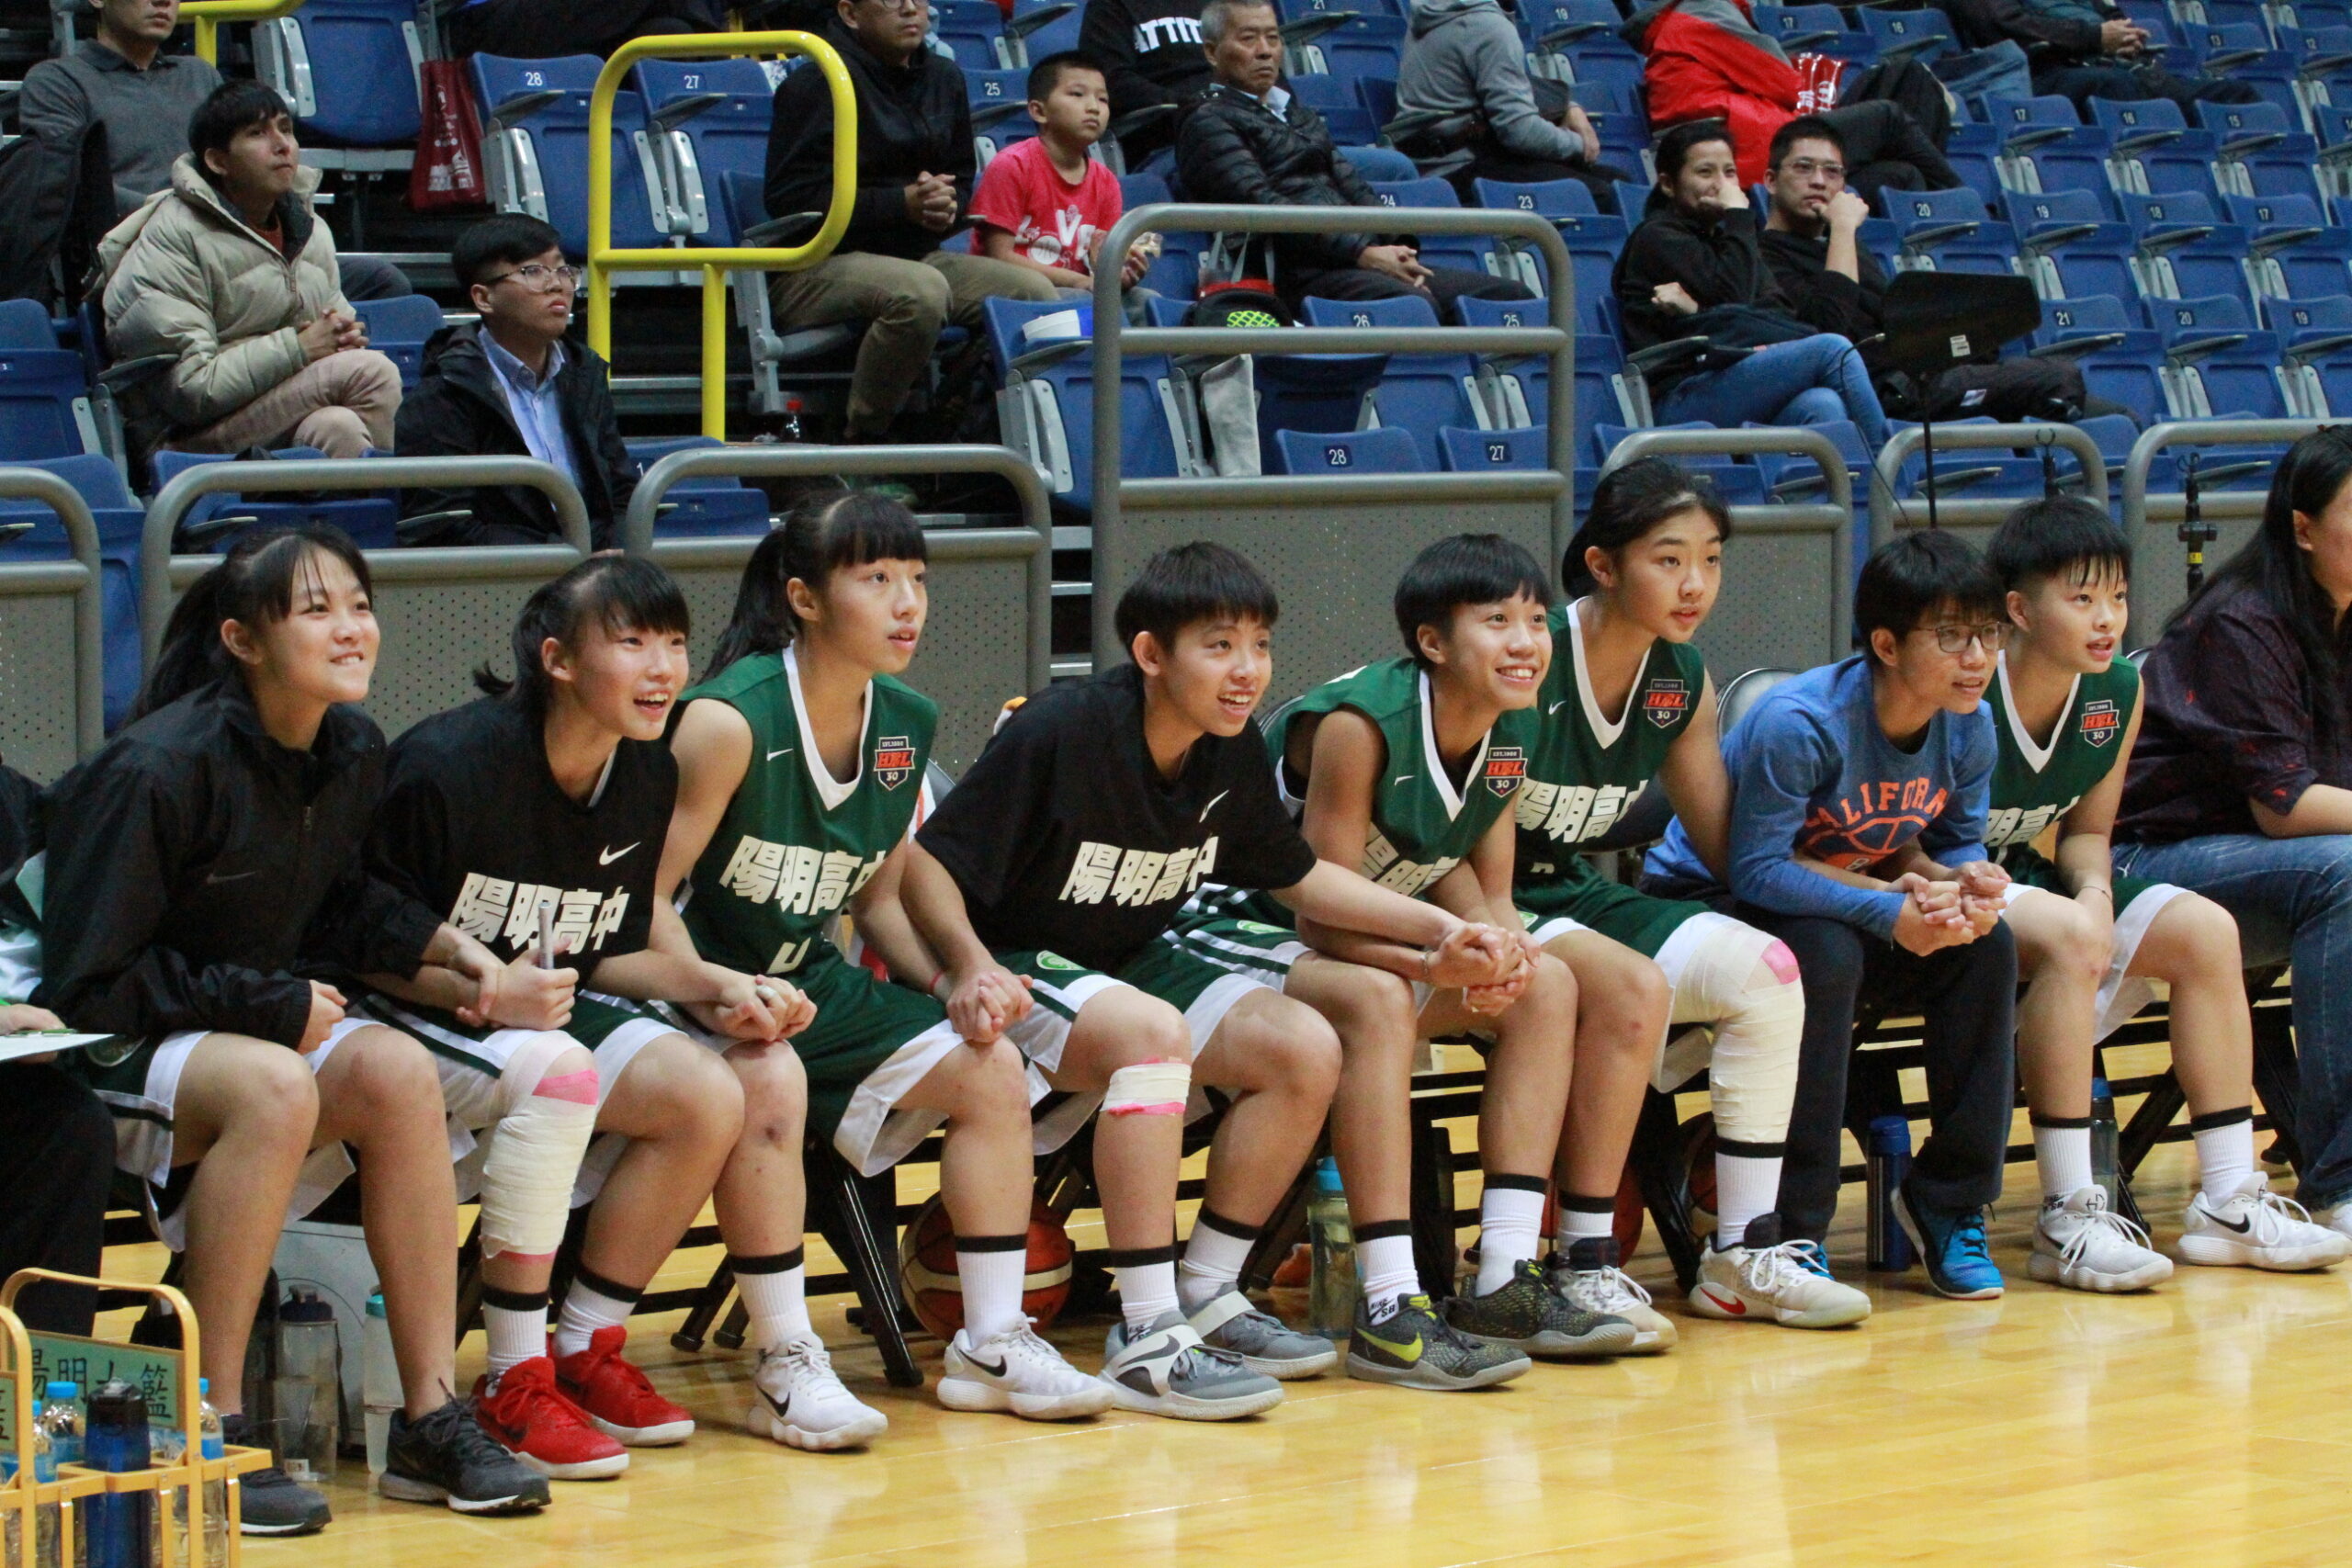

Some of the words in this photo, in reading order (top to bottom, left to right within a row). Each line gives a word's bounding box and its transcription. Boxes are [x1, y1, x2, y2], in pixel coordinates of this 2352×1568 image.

[526, 72, 543, 86] 28
[684, 74, 699, 89] 27
[985, 82, 1001, 96] 25
[1518, 195, 1533, 209] 23
[1917, 203, 1931, 218] 20
[2036, 205, 2049, 219] 19
[2258, 208, 2268, 220] 17
[1353, 314, 1370, 328] 26
[1503, 314, 1520, 327] 25
[2056, 311, 2071, 326] 21
[2178, 311, 2192, 325] 20
[2295, 311, 2308, 325] 19
[1329, 448, 1347, 465] 28
[1489, 446, 1504, 461] 27
[1657, 711, 1671, 720] 30
[2093, 731, 2105, 740] 30
[886, 772, 899, 782] 30
[1496, 780, 1510, 789] 30
[1058, 832, 1219, 907] 陽明高中
[448, 872, 630, 954] 陽明高中
